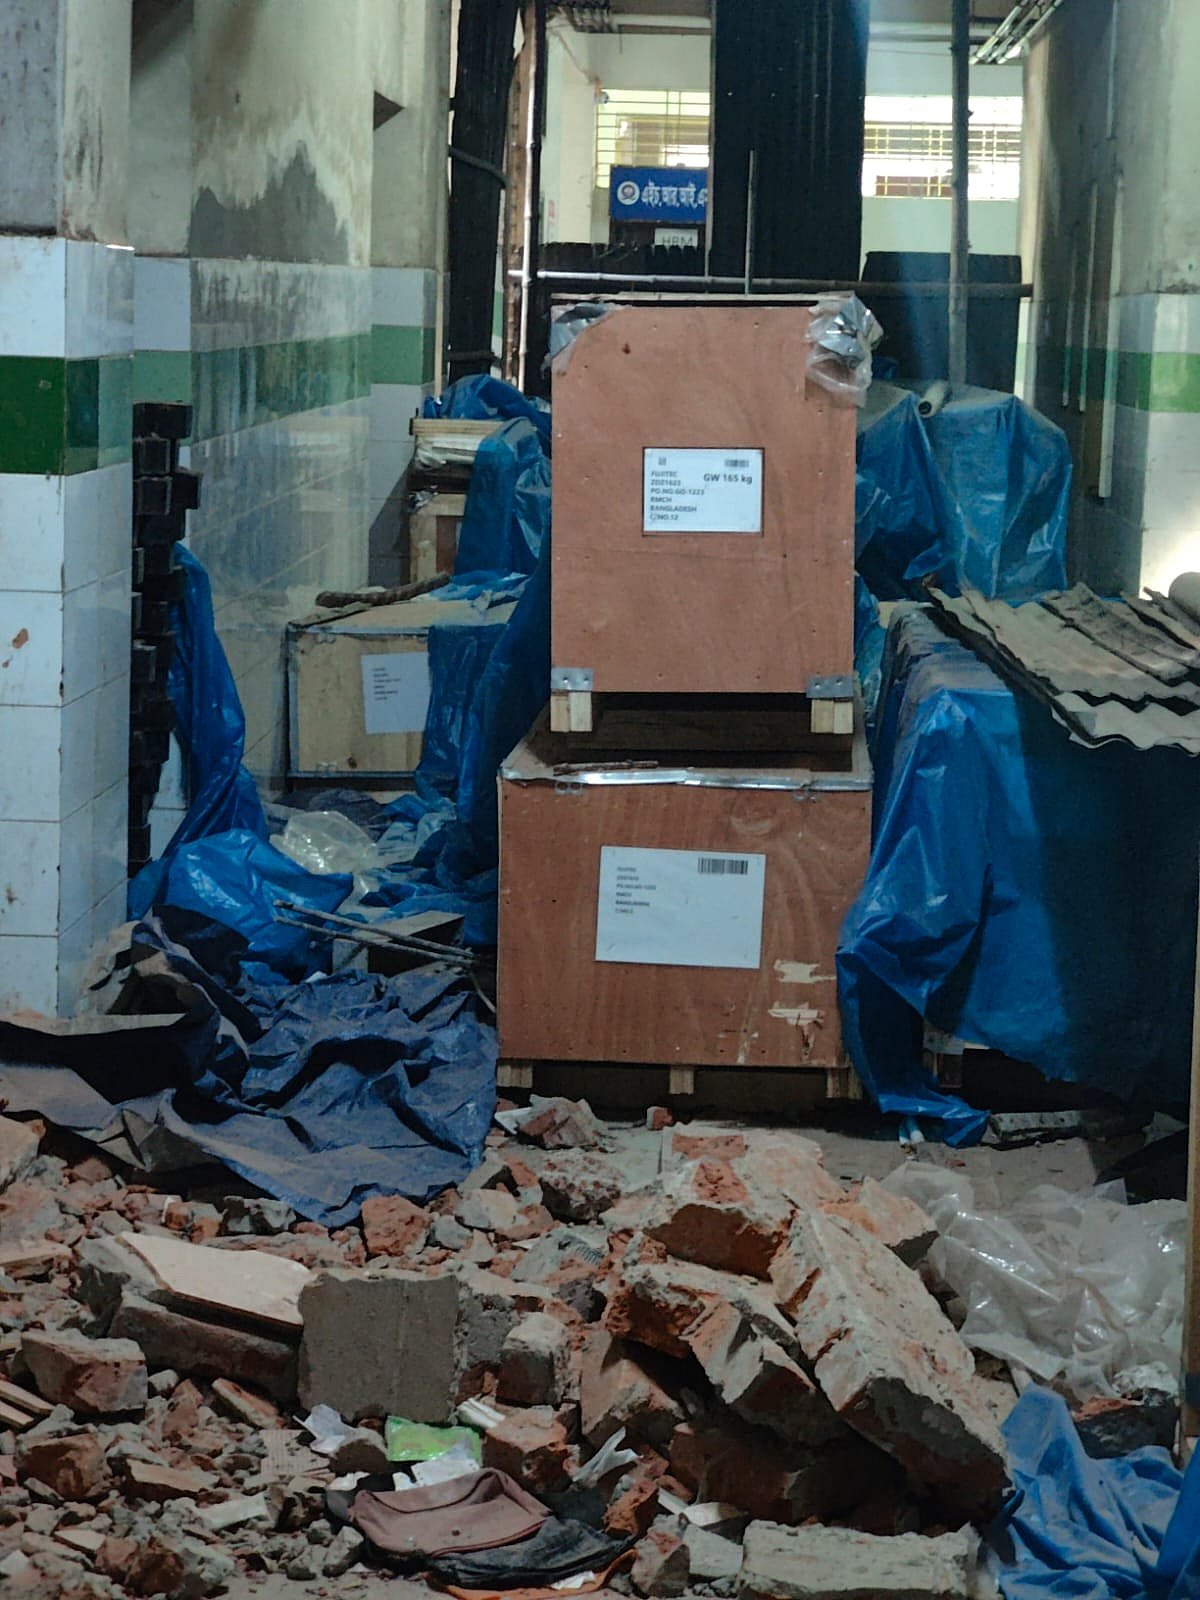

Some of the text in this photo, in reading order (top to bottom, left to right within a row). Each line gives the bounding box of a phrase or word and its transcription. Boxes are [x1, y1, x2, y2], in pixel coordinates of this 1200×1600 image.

[703, 473, 753, 485] GW 165 kg
